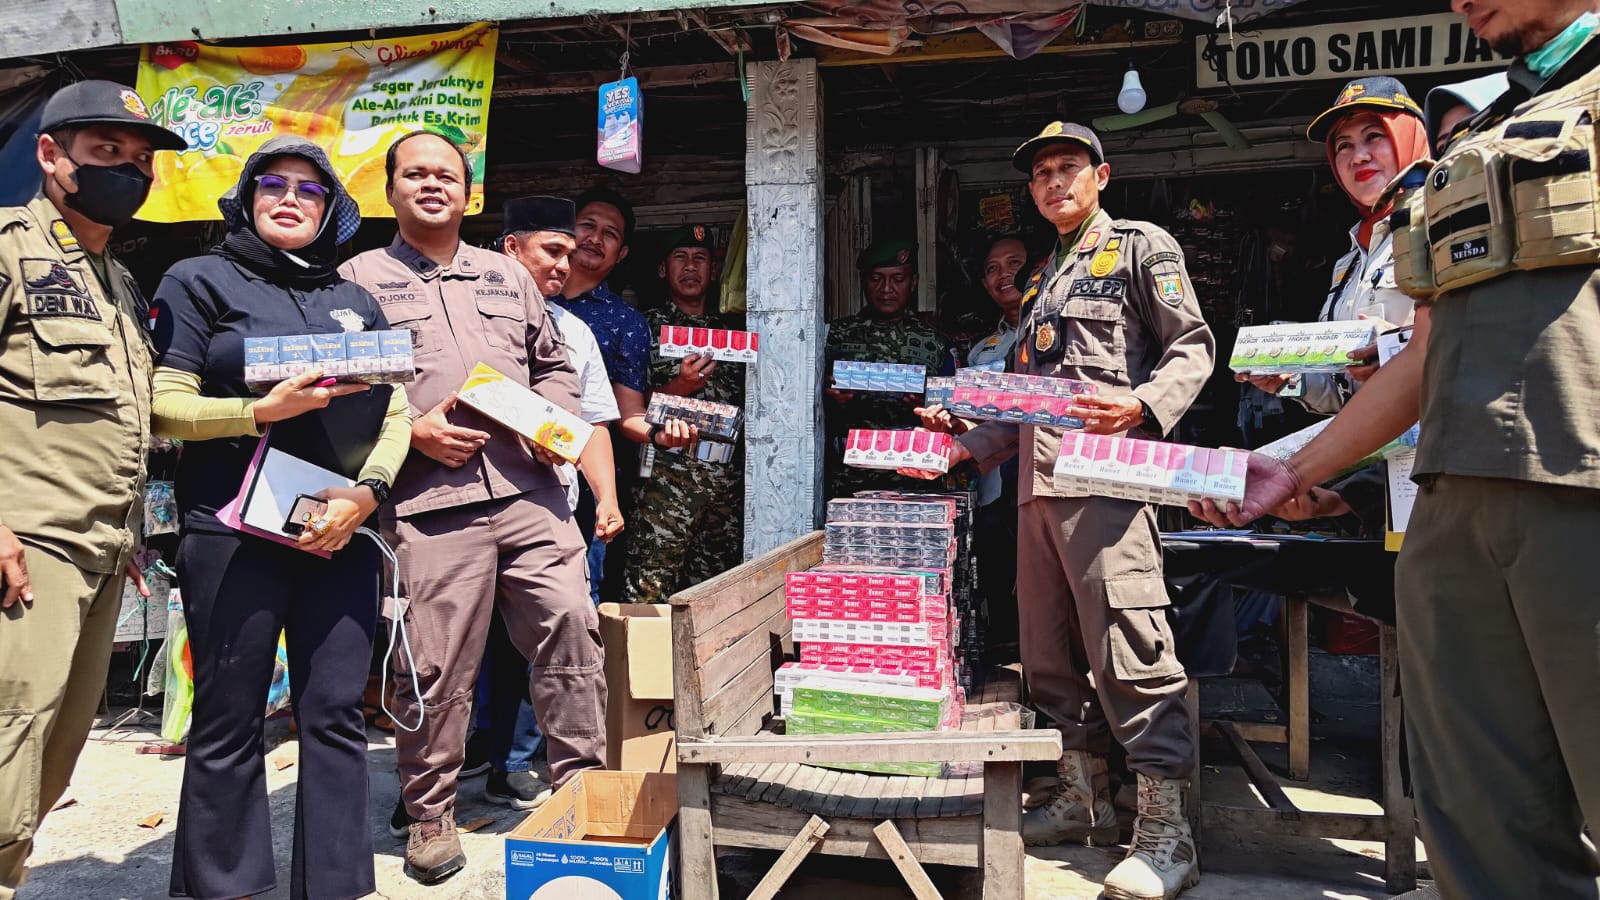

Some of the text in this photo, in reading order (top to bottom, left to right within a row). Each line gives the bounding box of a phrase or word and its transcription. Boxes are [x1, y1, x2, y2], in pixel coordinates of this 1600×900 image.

[1213, 23, 1514, 82] TOKO SAMI JA
[372, 76, 484, 94] Segar Jeruknya
[352, 93, 483, 111] Ale-Ale Kini Dalam
[605, 87, 630, 103] YES
[424, 111, 442, 123] Es
[447, 111, 481, 126] Krim
[225, 121, 273, 136] Jeruk
[1452, 245, 1486, 260] NEISDA
[379, 293, 415, 303] DJOKO
[475, 289, 520, 300] KEJAKSAAN
